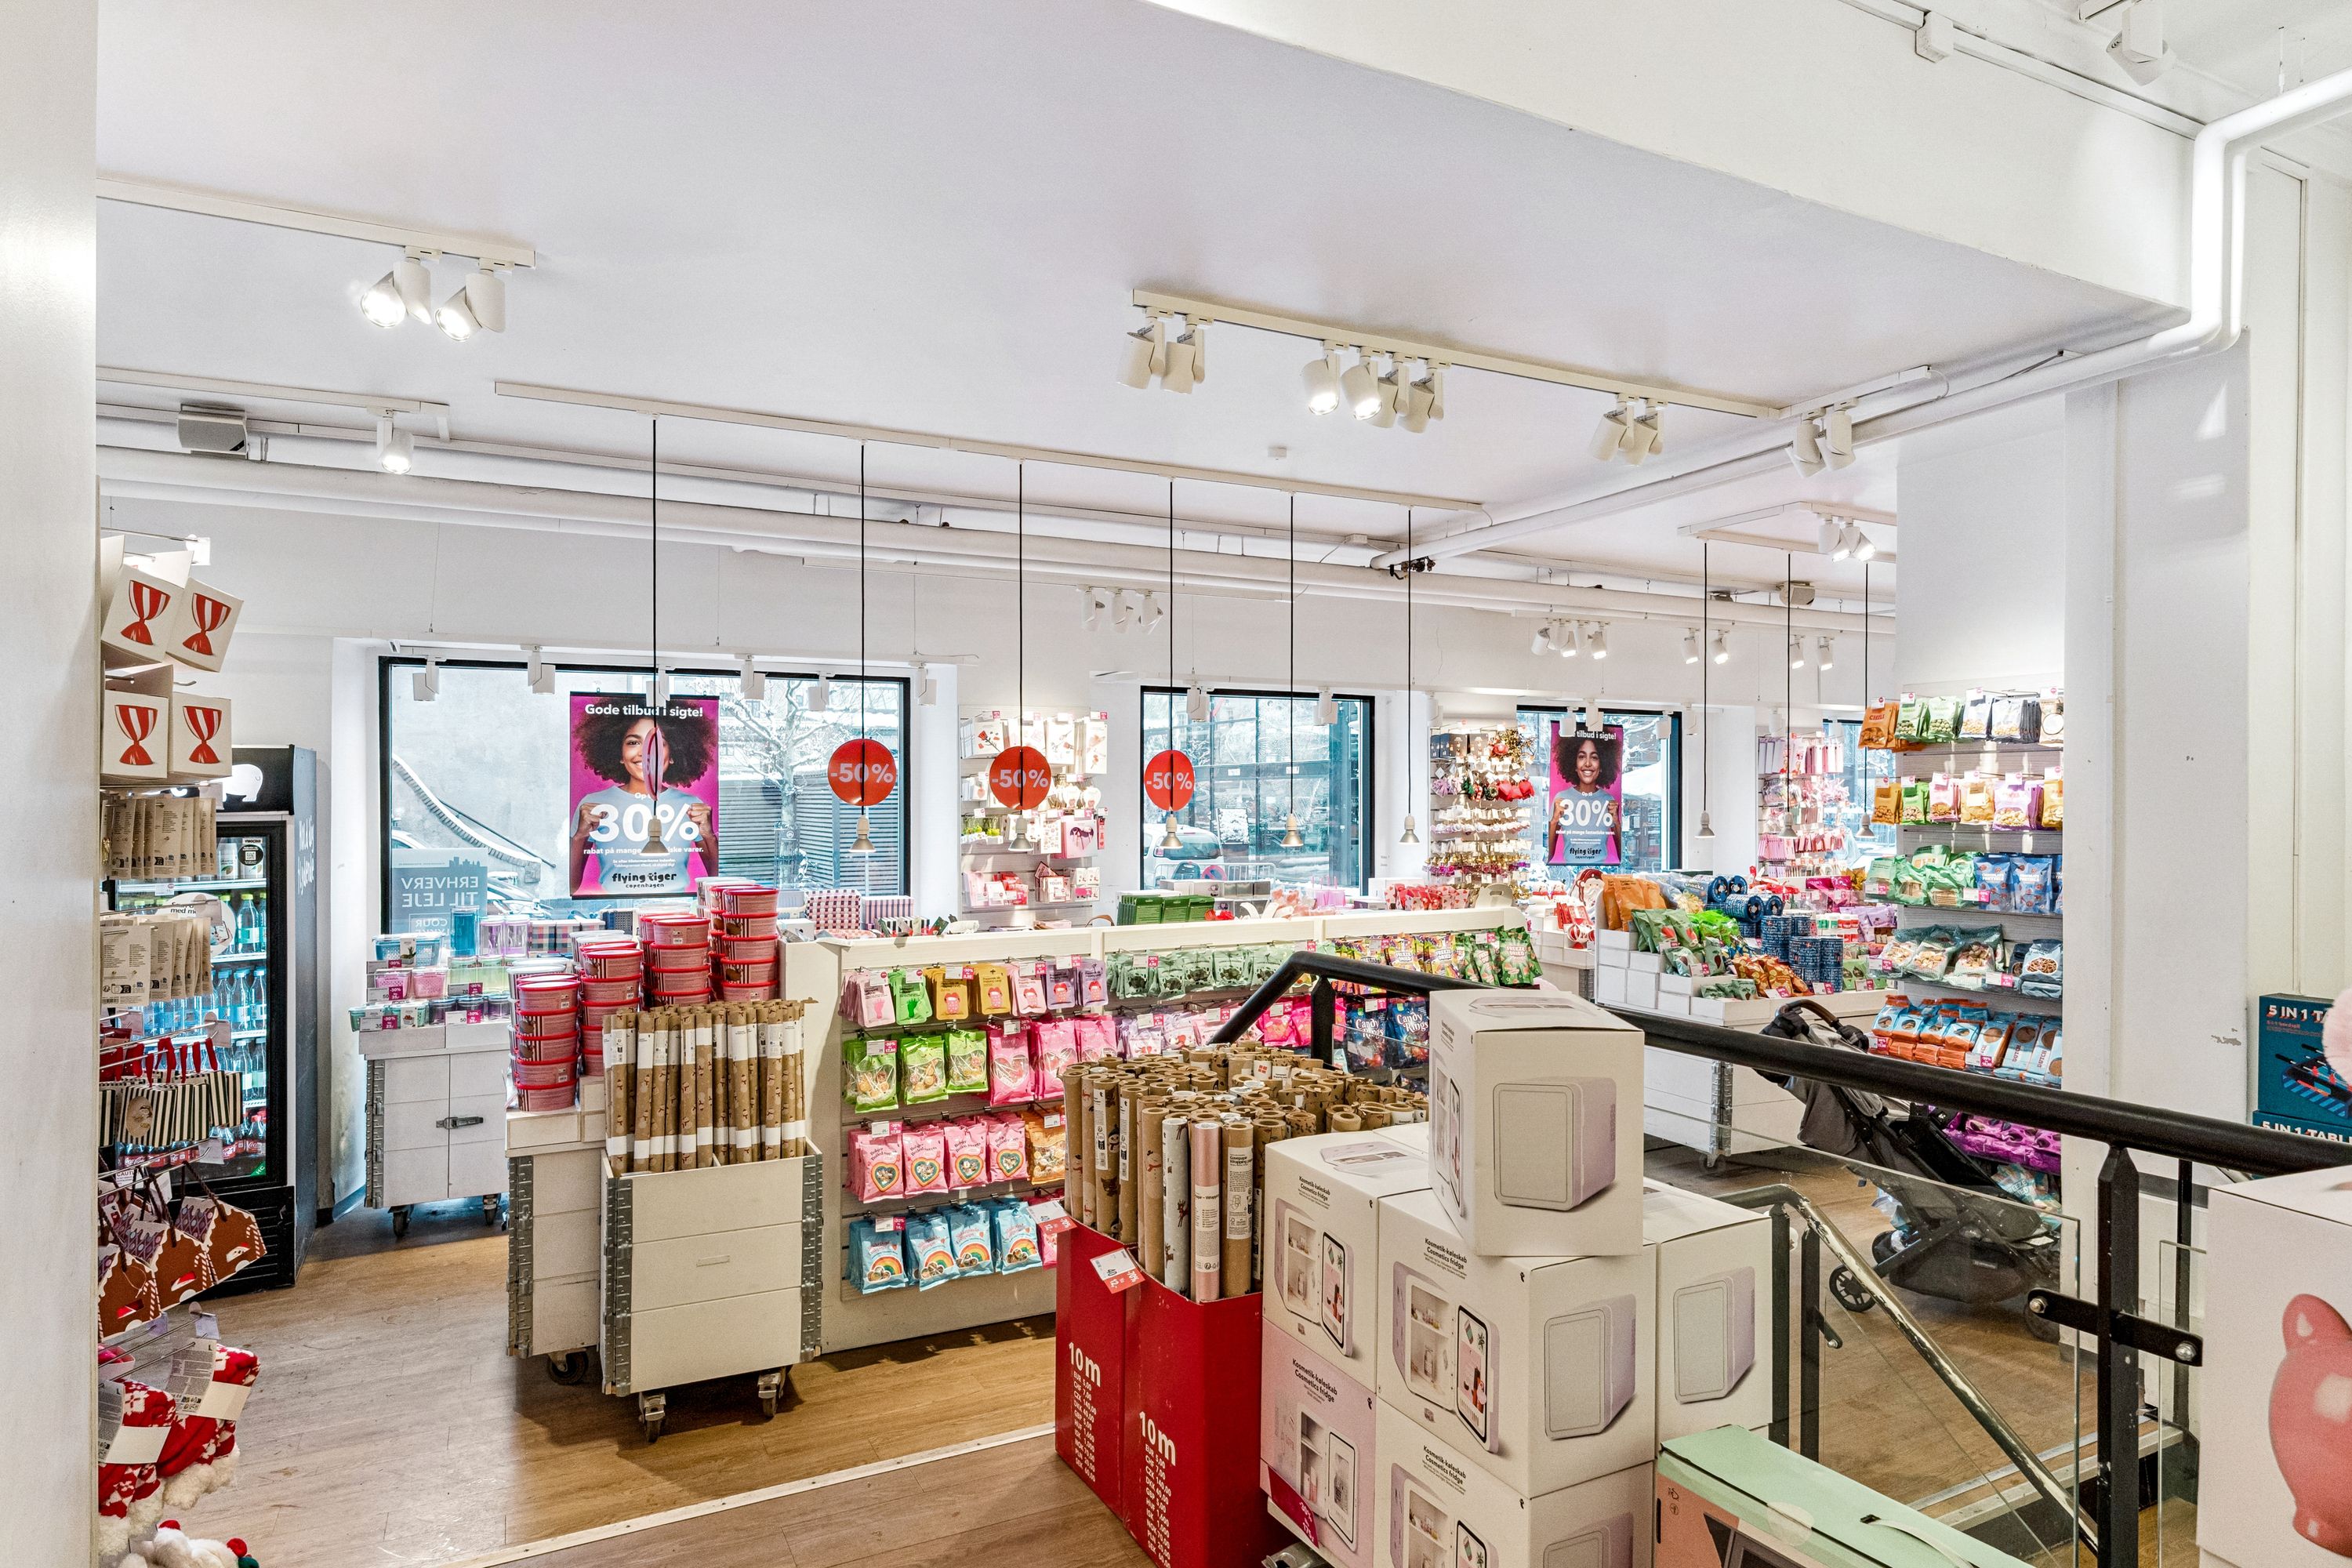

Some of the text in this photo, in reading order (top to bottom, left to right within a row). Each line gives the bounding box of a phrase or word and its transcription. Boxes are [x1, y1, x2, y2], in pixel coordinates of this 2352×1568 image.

[585, 703, 703, 720] Gode tilbud i sigte!
[1599, 731, 1617, 741] sigte!
[831, 763, 894, 783] -50%
[991, 769, 1049, 788] -50%
[1146, 771, 1192, 790] -50%
[635, 792, 646, 800] Op
[1559, 799, 1613, 827] 30%
[589, 803, 699, 843] 30%
[583, 846, 604, 855] rabat
[605, 845, 615, 855] på
[1570, 847, 1587, 855] flying
[612, 872, 677, 884] flying tiger
[1396, 1011, 1422, 1025] Candy
[2269, 1004, 2278, 1016] 5
[2281, 1006, 2297, 1018] IN
[2300, 1008, 2308, 1019] 1
[1356, 1018, 1380, 1029] Candy
[1403, 1022, 1428, 1033] Rings
[1359, 1028, 1384, 1039] Rings
[2013, 1044, 2022, 1062] DUTCH
[2038, 1050, 2047, 1067] DUTCH
[2262, 1120, 2270, 1129] 5
[2274, 1123, 2291, 1133] IN
[2295, 1127, 2302, 1135] 1
[256, 1166, 265, 1174] HC
[1301, 1183, 1317, 1196] Cosmetics
[1317, 1192, 1328, 1201] fridge
[1427, 1247, 1449, 1262] Cosmetics
[1450, 1258, 1464, 1269] fridge
[1295, 1369, 1319, 1391] Cosmetics
[1319, 1386, 1334, 1402] fridge
[1145, 1444, 1154, 1457] EUR
[1145, 1455, 1154, 1468] CHF
[1145, 1466, 1154, 1479] CZK
[1425, 1455, 1448, 1474] Cosmetics
[1449, 1471, 1463, 1484] fridge
[1146, 1476, 1155, 1491] DKK
[1146, 1487, 1155, 1500] GBP
[1146, 1497, 1155, 1511] HUF
[1147, 1519, 1157, 1535] NOK
[1148, 1540, 1156, 1554] SEK
